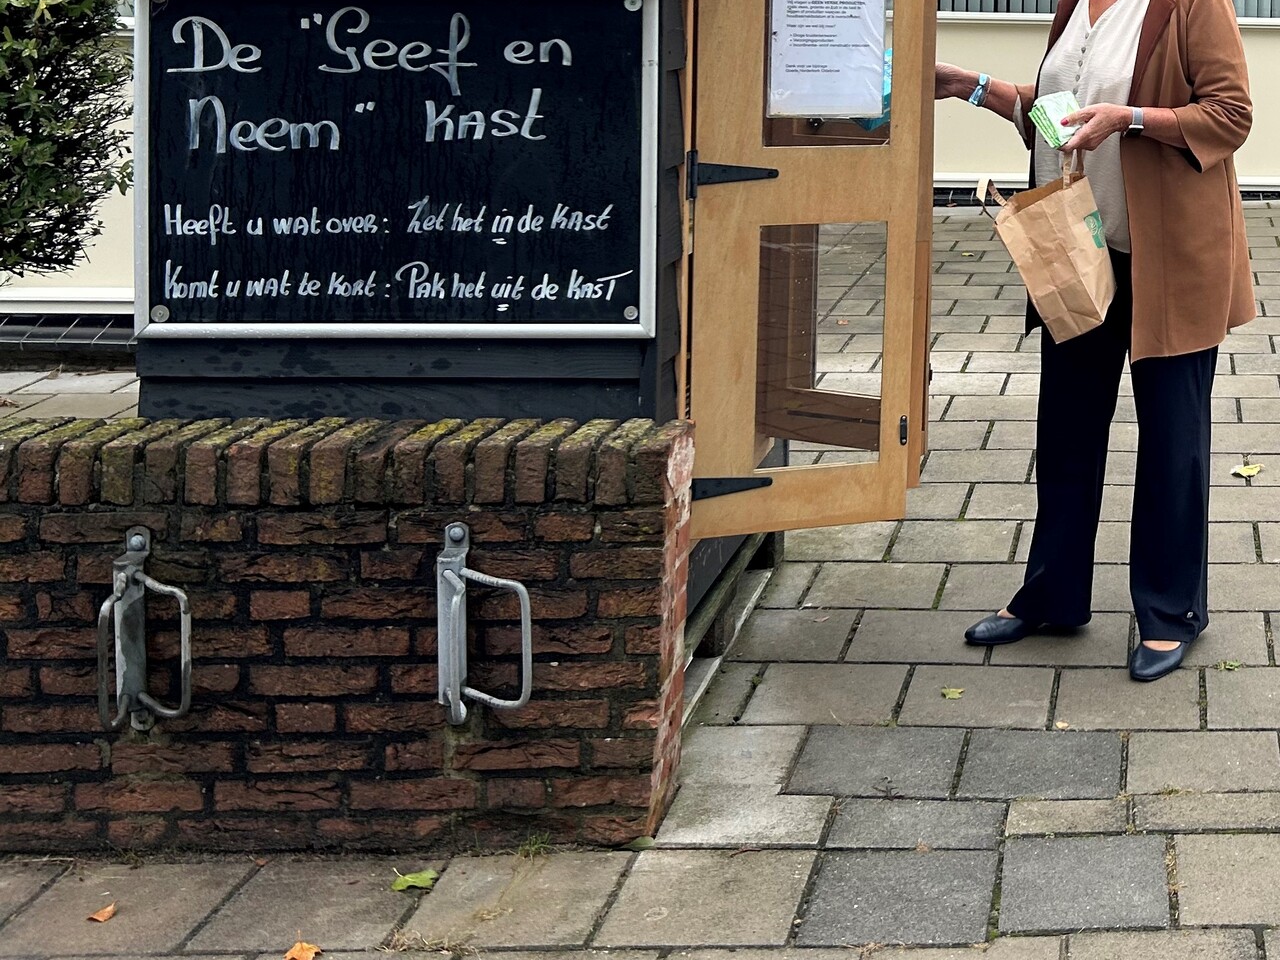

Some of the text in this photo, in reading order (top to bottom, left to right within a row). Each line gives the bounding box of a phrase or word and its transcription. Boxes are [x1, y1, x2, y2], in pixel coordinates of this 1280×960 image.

[166, 16, 262, 73] De
[503, 38, 572, 66] en
[164, 203, 237, 246] Heeft
[246, 217, 263, 236] u
[406, 195, 450, 233] Zet
[450, 202, 486, 232] het
[490, 208, 514, 234] in
[517, 204, 544, 234] de
[165, 259, 220, 299] Komt
[225, 280, 242, 298] u
[298, 271, 322, 297] te
[451, 271, 486, 299] het
[490, 275, 525, 300] uit
[531, 273, 560, 301] de
